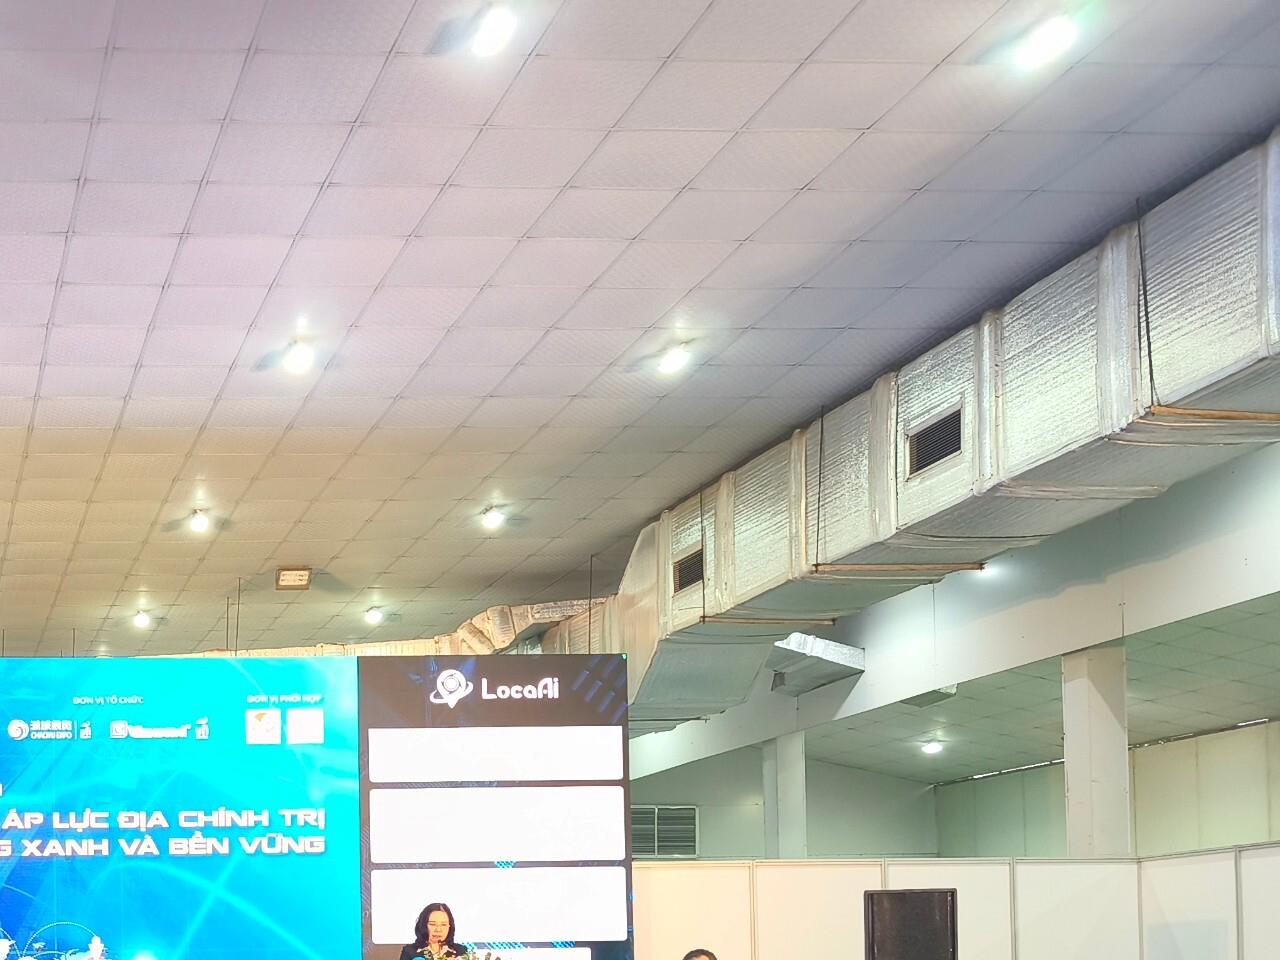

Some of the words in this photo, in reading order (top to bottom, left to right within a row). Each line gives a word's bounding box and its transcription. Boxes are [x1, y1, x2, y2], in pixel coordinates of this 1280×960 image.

[481, 677, 560, 700] LocaAi
[1, 808, 44, 830] ÁP
[52, 807, 109, 833] LỰC
[117, 810, 169, 832] ĐỊA
[178, 806, 269, 828] CHÍNH
[278, 808, 325, 830] TRỊ
[21, 839, 109, 857] XANH
[118, 835, 160, 856] VÀ
[168, 831, 229, 856] BỀN
[238, 832, 326, 855] VỮNG
